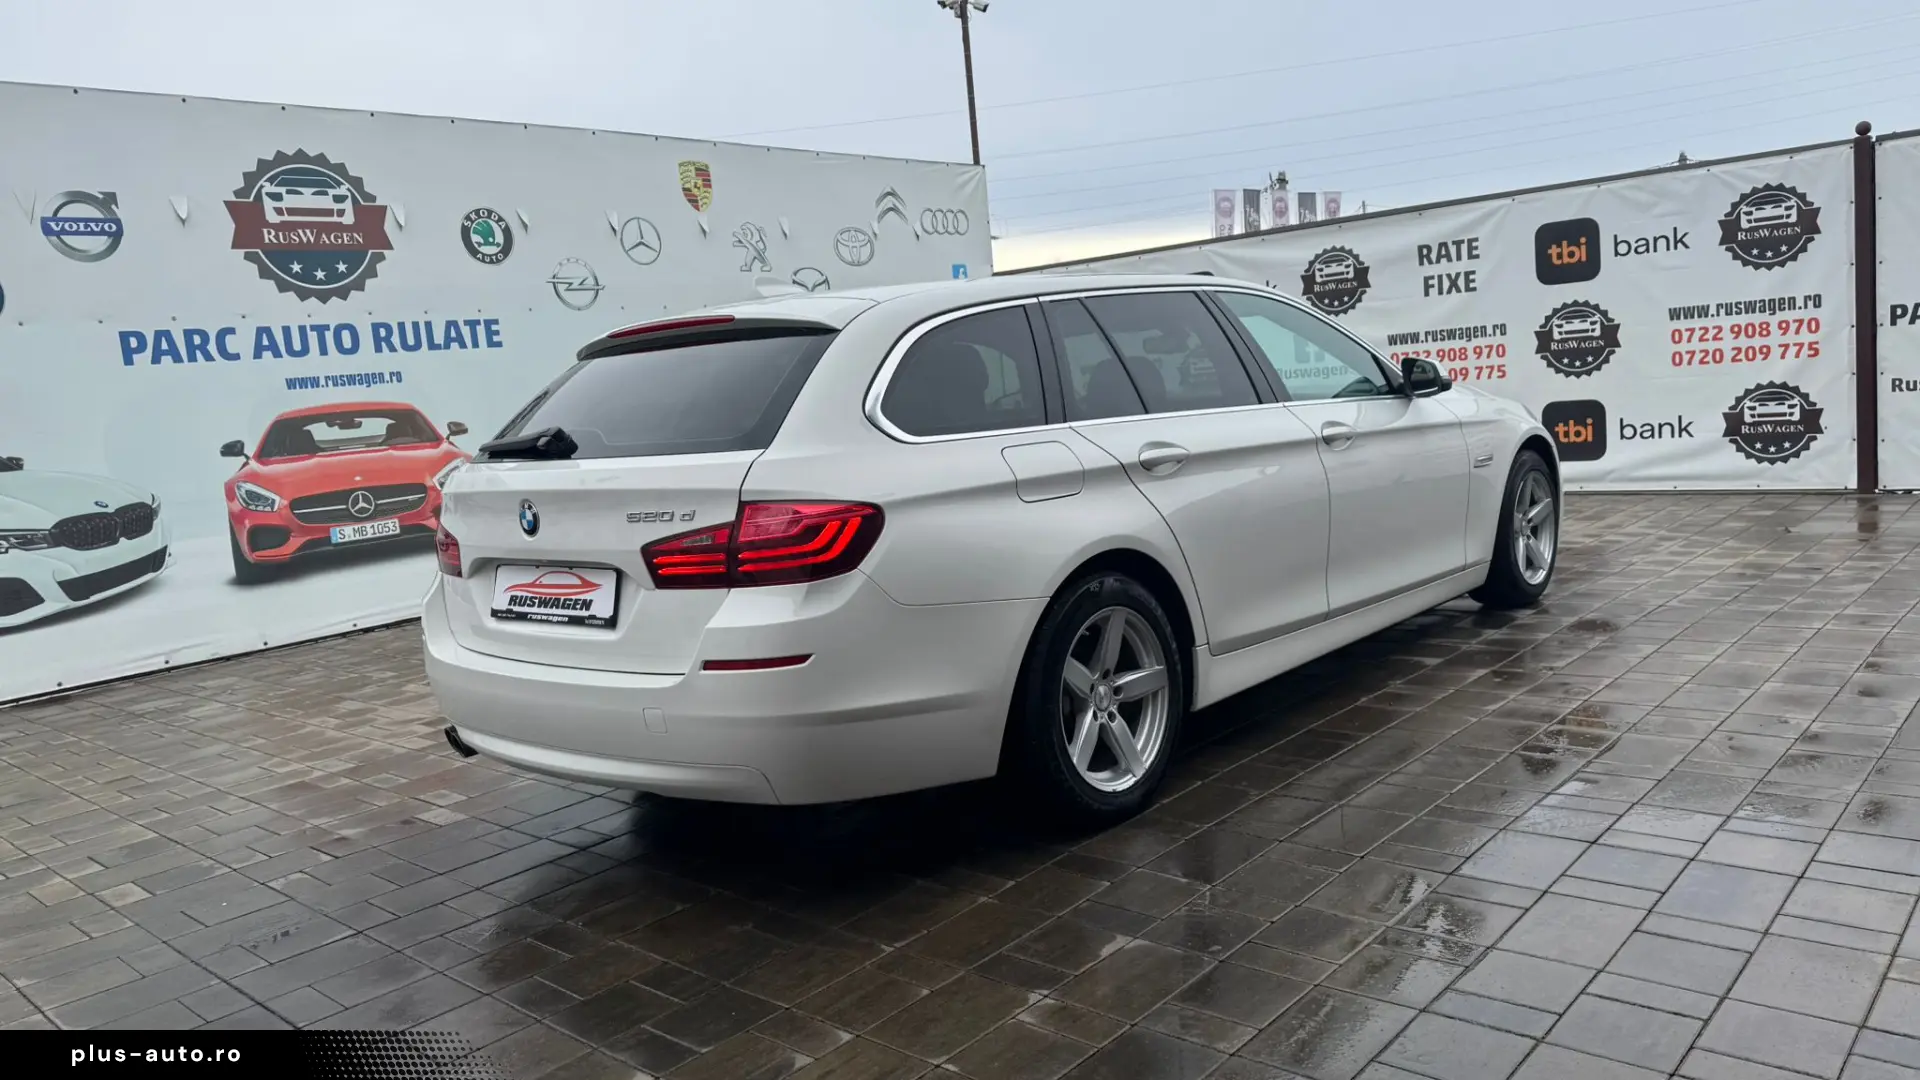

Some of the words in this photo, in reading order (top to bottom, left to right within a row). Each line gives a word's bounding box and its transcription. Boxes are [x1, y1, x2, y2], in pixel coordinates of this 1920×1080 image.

[47, 221, 117, 232] VOLVO
[463, 209, 507, 228] SKODA
[1417, 237, 1481, 266] RATE
[1548, 236, 1587, 265] tbi
[1613, 226, 1690, 257] bank
[476, 252, 504, 263] AUTO
[1423, 270, 1478, 297] FIXE
[1668, 294, 1823, 321] www.ruswagen.ro
[1387, 323, 1508, 346] www.ruswagen.ro
[1670, 325, 1724, 344] 0722
[1729, 321, 1771, 340] 908
[1777, 317, 1821, 336] 970
[119, 326, 242, 366] PARC
[252, 321, 361, 360] AUTO
[371, 318, 504, 354] RULATE
[1436, 347, 1469, 363] 908
[1473, 343, 1507, 359] 970
[1671, 348, 1725, 367] 0720
[1730, 344, 1771, 363] 209
[1777, 341, 1821, 360] 775
[285, 371, 403, 391] www.ruswagen.ro
[1448, 367, 1469, 382] 09
[1475, 364, 1507, 380] 775
[1891, 378, 1920, 393] Ru
[1554, 418, 1594, 443] tbi
[1619, 415, 1694, 440] bank
[626, 510, 675, 523] 520
[679, 509, 697, 521] d
[338, 528, 346, 540] S
[352, 525, 368, 538] MB
[369, 521, 398, 536] 1053
[507, 594, 594, 612] RUSWAGEN
[527, 612, 569, 623] ruswagen
